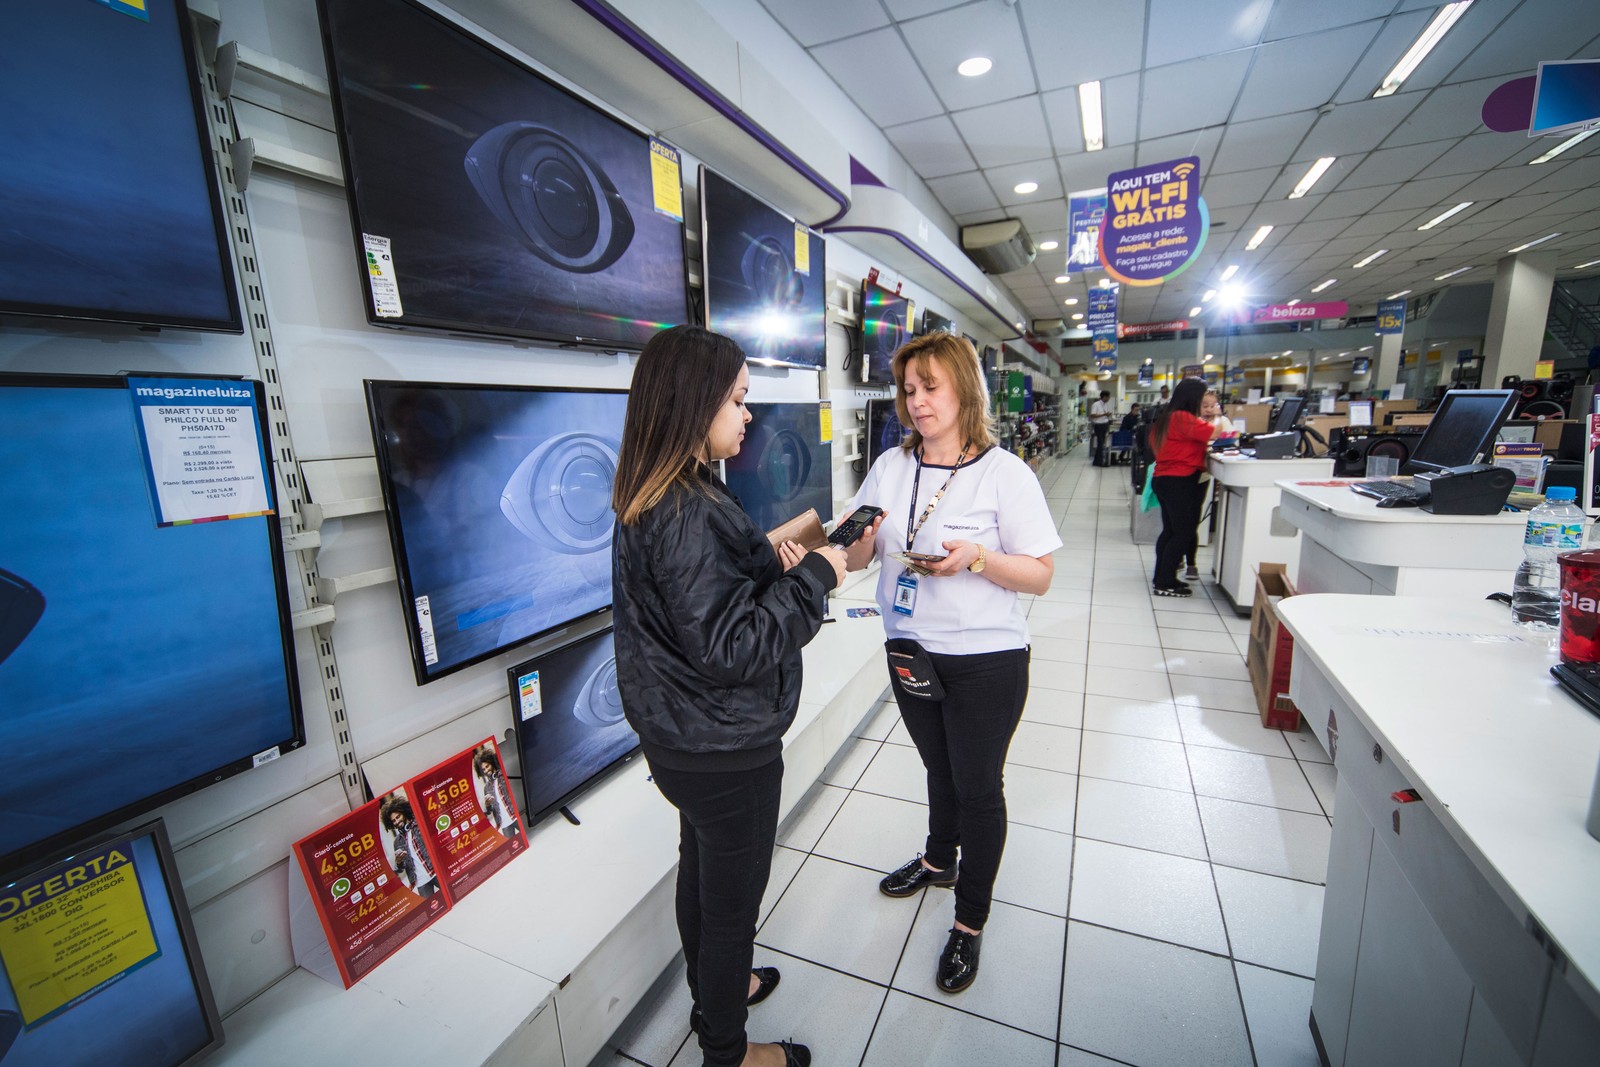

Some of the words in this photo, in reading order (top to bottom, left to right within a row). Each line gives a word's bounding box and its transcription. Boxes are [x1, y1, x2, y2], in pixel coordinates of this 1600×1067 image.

[650, 140, 678, 162] OFERTA
[1112, 176, 1142, 192] AQUI
[1144, 171, 1170, 185] TEM
[1112, 179, 1188, 213] WI-FI
[1112, 204, 1186, 230] GRÁTIS
[1116, 234, 1188, 254] magalu_cliente
[1120, 231, 1152, 244] Acesse
[1162, 226, 1185, 237] rede:
[1116, 258, 1136, 266] Faça
[1152, 249, 1188, 260] cadastro
[1137, 260, 1172, 272] navegue
[1089, 312, 1115, 320] PREÇOS
[1272, 306, 1316, 318] beleza
[1378, 315, 1401, 328] 15x
[1125, 321, 1184, 333] eletroportáteis
[1094, 340, 1115, 351] 15x
[136, 387, 251, 399] magazineluiza
[422, 787, 434, 795] Claro
[436, 777, 452, 788] controle
[428, 790, 448, 811] 4,5
[449, 779, 469, 798] GB
[314, 846, 331, 857] Claro
[332, 833, 353, 847] controle
[321, 848, 347, 875] 4,5
[349, 833, 374, 857] GB
[0, 850, 127, 918] OFERTA
[13, 908, 56, 932] 32L1800
[59, 875, 124, 911] CONVERSOR
[14, 912, 27, 923] TV
[31, 901, 53, 915] LED
[76, 870, 120, 893] TOSHIBA
[63, 904, 83, 916] DIG
